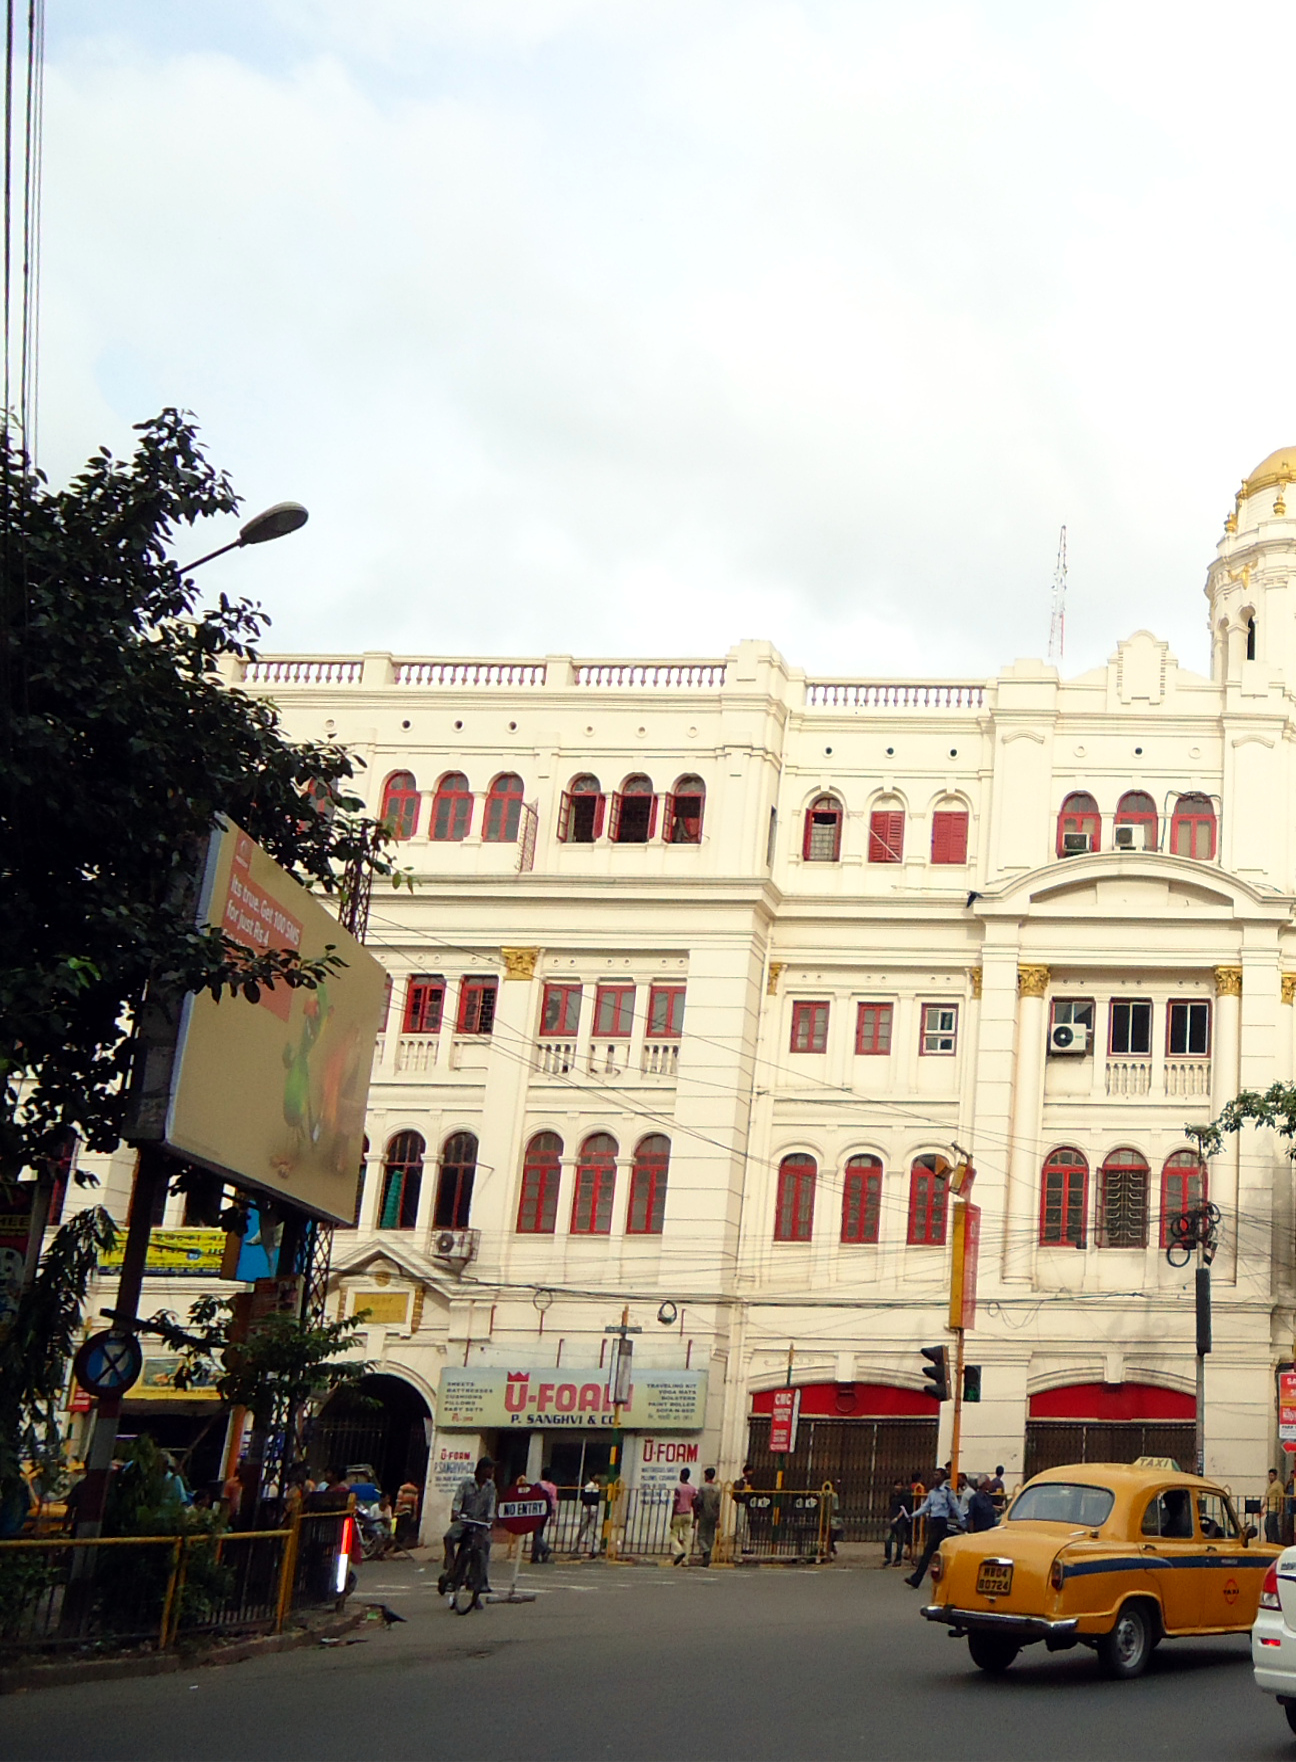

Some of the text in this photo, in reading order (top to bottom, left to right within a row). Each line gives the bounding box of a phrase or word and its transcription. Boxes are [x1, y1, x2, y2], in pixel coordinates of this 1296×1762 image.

[227, 899, 239, 922] for
[237, 909, 254, 935] just
[511, 1414, 521, 1423] P.
[527, 1414, 582, 1424] SANGHVI
[587, 1415, 596, 1424] &
[1140, 1458, 1169, 1467] TAXI
[503, 1502, 544, 1515] NO ENTRY
